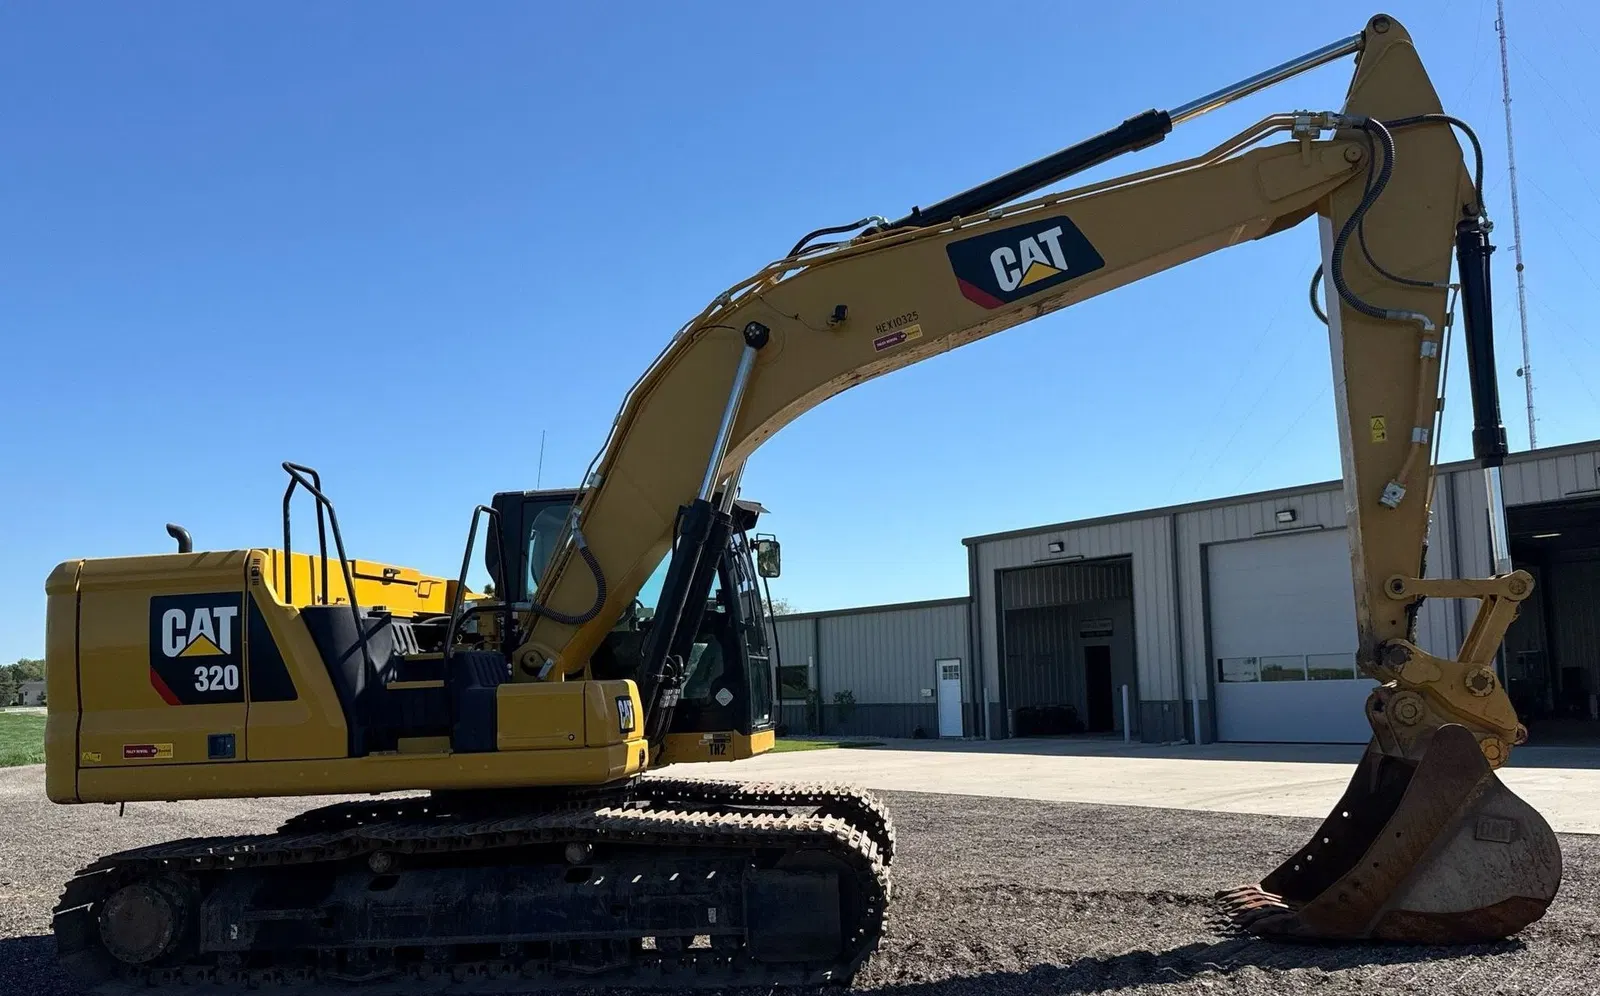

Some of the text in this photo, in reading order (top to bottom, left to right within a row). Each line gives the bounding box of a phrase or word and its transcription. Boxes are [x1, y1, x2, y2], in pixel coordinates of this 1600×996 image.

[990, 226, 1068, 292] CAT
[876, 311, 919, 334] HEX10325
[162, 606, 238, 658] CAT
[194, 665, 239, 692] 320
[618, 699, 634, 729] CAT
[709, 743, 726, 756] TH2
